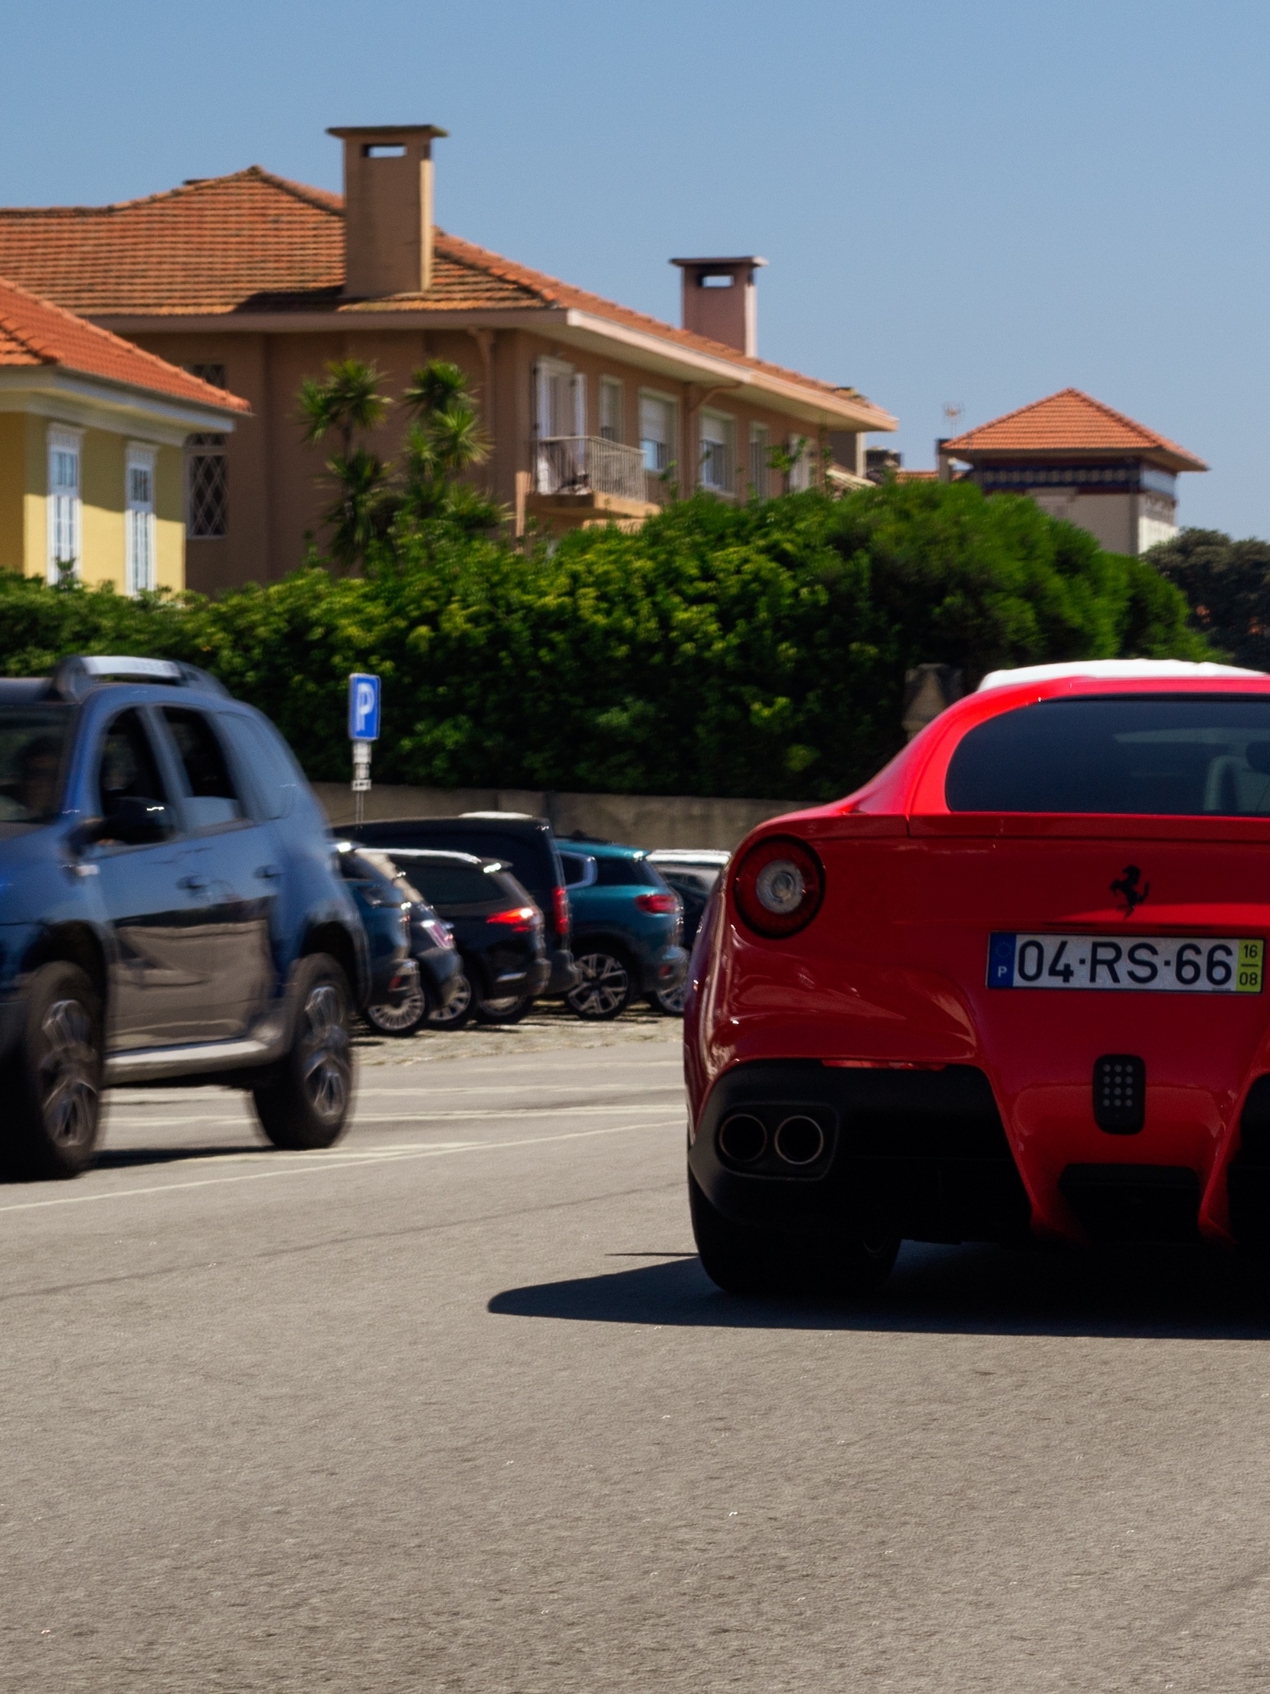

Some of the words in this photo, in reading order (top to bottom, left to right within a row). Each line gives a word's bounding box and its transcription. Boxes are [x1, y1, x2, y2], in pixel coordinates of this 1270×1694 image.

[357, 682, 375, 731] P
[1243, 944, 1258, 959] 16
[997, 966, 1008, 978] P
[1239, 972, 1258, 986] 08
